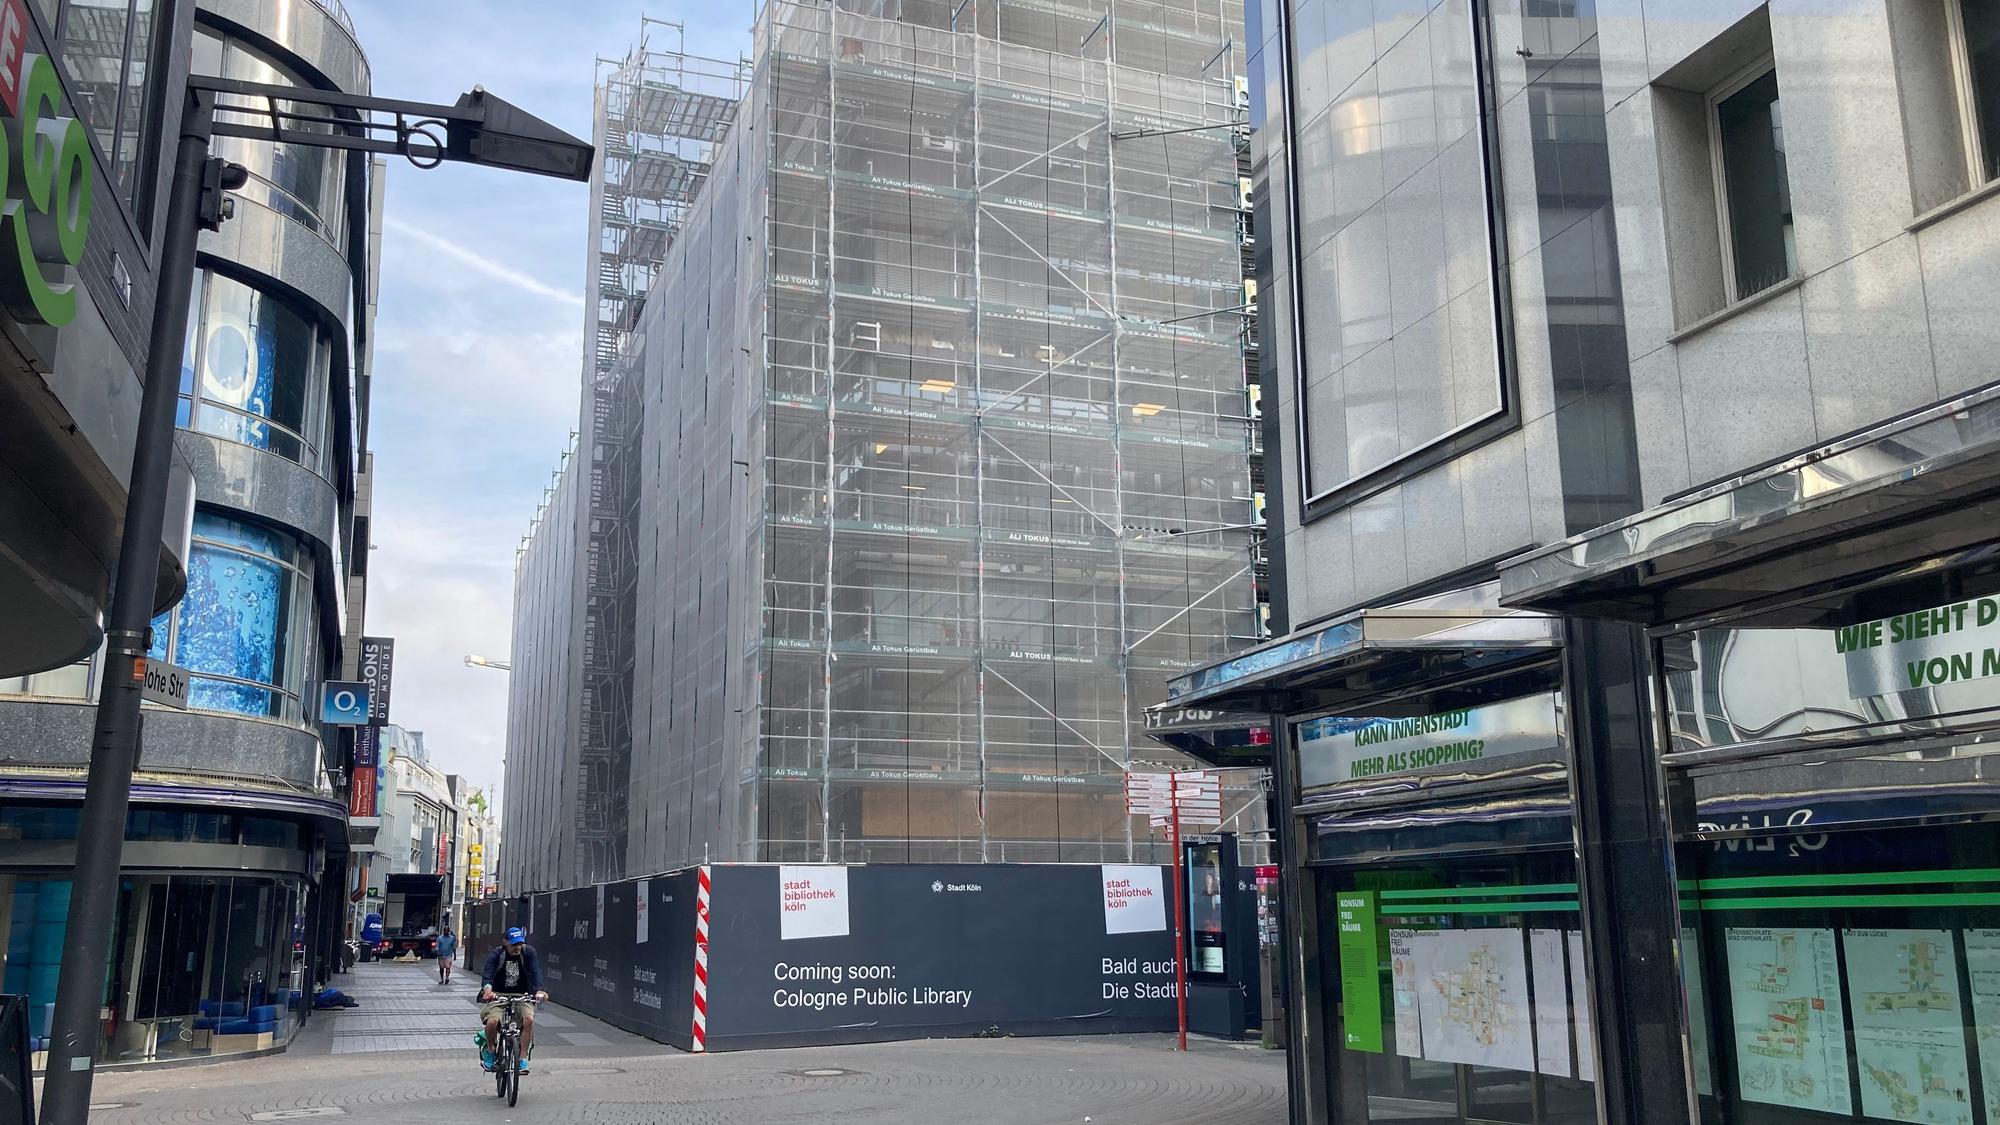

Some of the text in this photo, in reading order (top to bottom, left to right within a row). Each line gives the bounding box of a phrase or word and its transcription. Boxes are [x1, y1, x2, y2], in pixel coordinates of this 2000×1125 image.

[1018, 200, 1043, 209] TOKUS
[1023, 534, 1050, 542] TOKUS
[1834, 620, 1882, 654] WIE
[1890, 602, 1968, 644] SIEHT
[790, 640, 810, 648] Tokus
[1024, 652, 1051, 660] TOKUS
[1907, 652, 1972, 688] VON
[168, 673, 184, 699] Str.
[379, 644, 391, 719] DU MONDE
[1355, 711, 1469, 748] KANN INNENSTADT
[1351, 740, 1484, 778] MEHR ALS SHOPPING?
[784, 880, 810, 890] stadt
[966, 883, 982, 891] Köln
[1107, 879, 1130, 888] stadt
[784, 889, 836, 900] bibliothek
[1108, 888, 1152, 898] bibliothek
[784, 902, 806, 912] köln
[1108, 900, 1128, 908] köln
[1340, 899, 1364, 907] KONSUM
[1341, 912, 1352, 920] FREI
[1342, 921, 1361, 932] RÄUME
[1102, 958, 1136, 974] Bald
[774, 962, 896, 984] Coming soon:
[1103, 983, 1128, 998] Die
[774, 988, 972, 1010] Cologne Public Library
